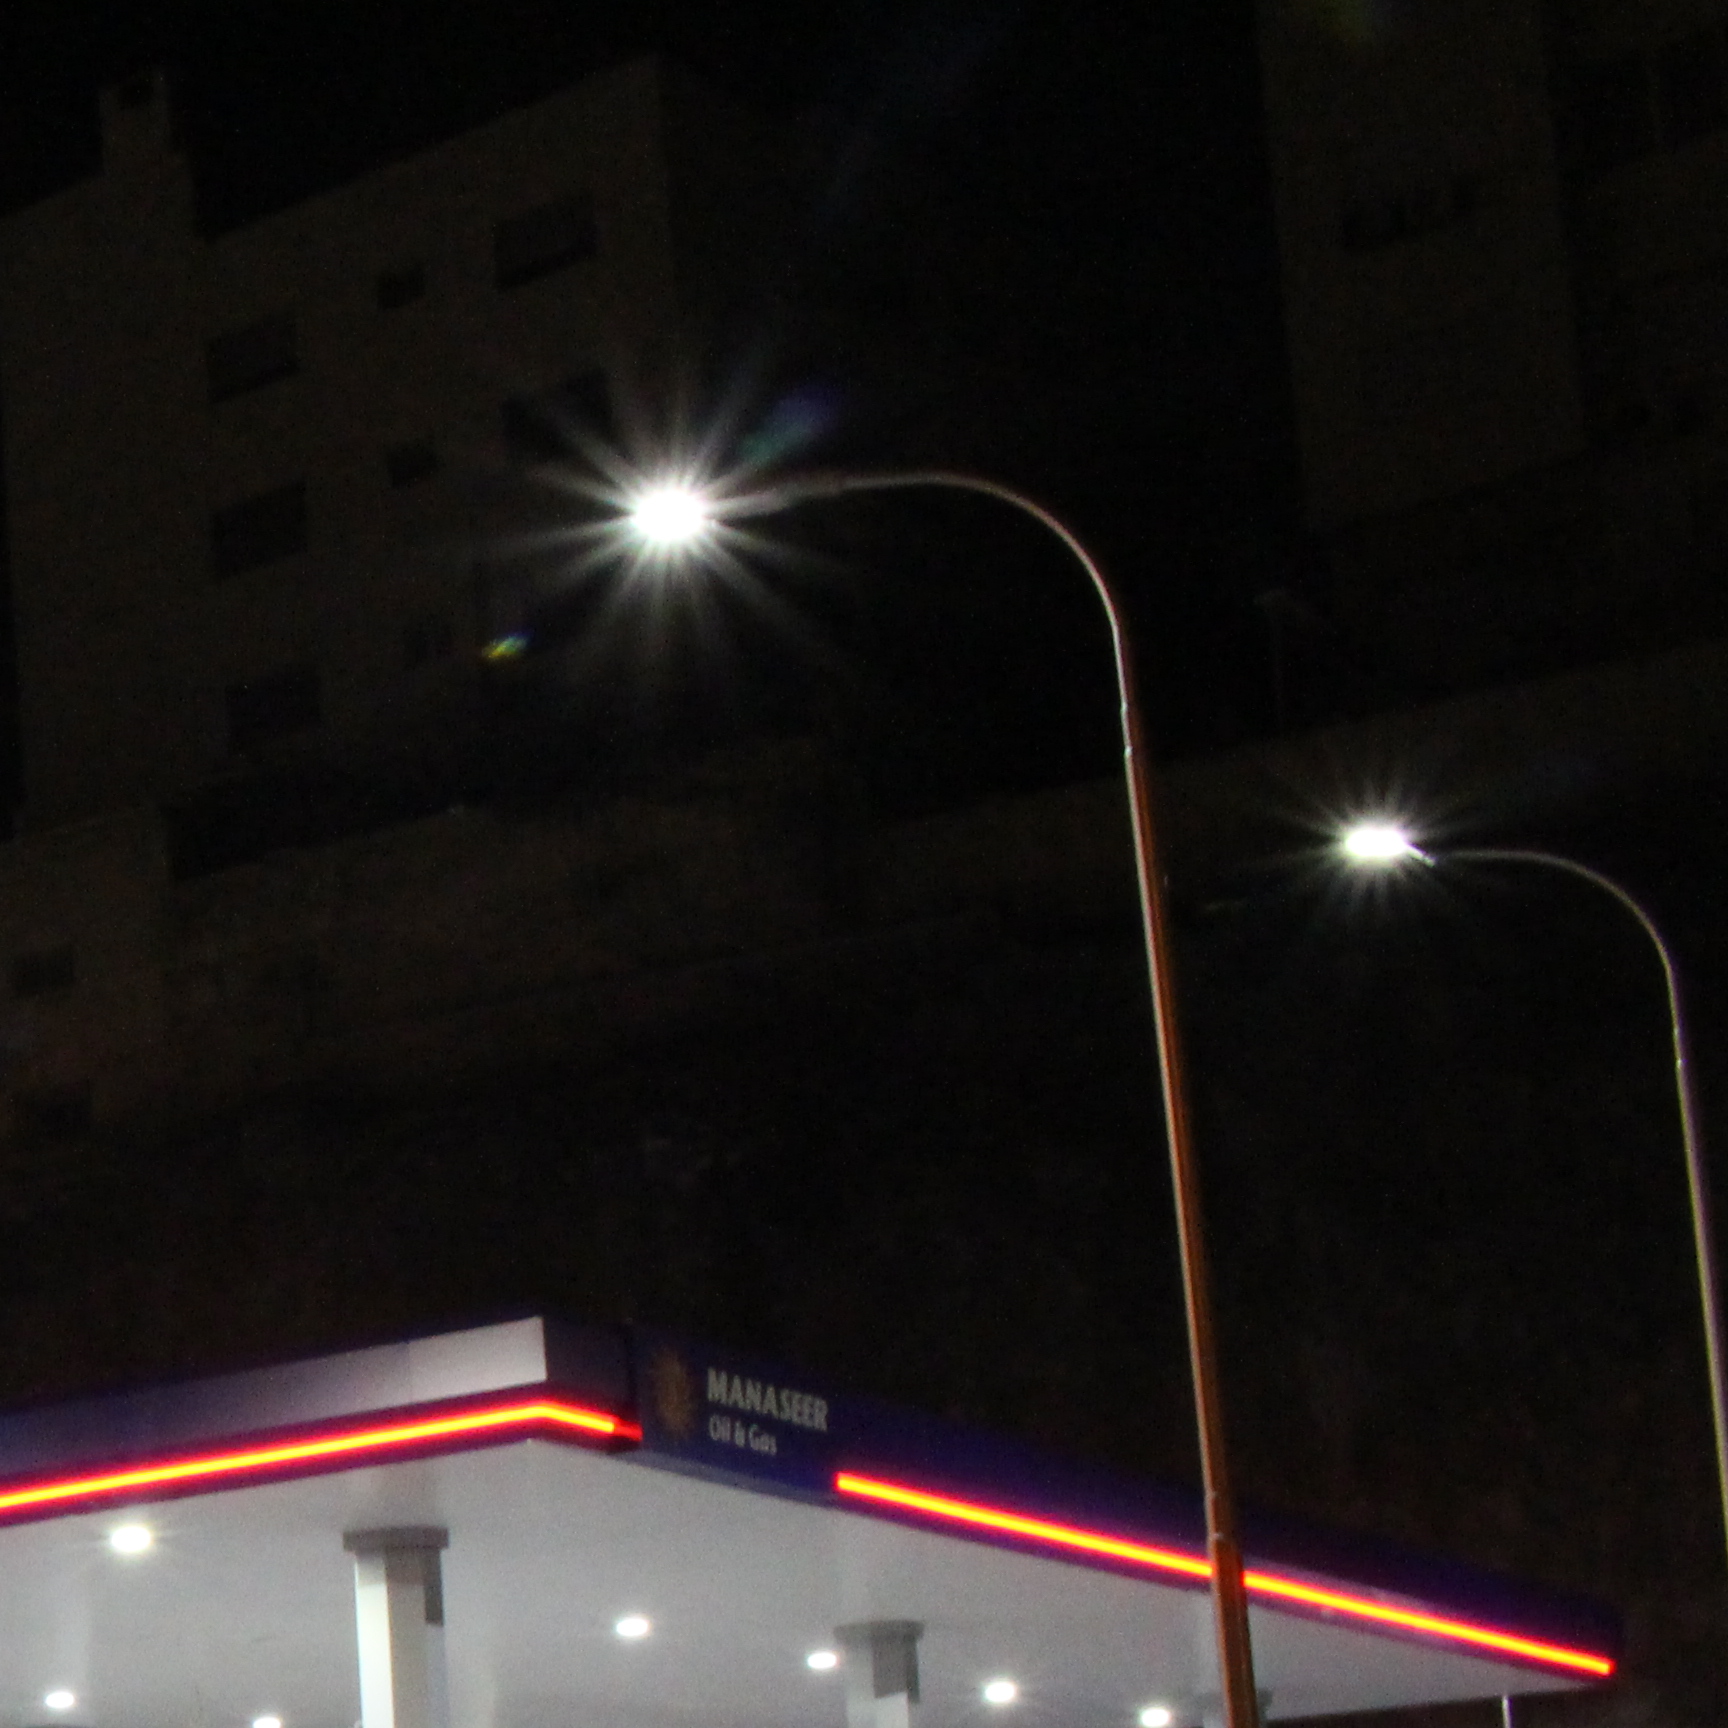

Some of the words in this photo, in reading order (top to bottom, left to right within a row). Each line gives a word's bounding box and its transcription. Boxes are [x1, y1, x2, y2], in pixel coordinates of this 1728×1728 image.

[707, 1367, 829, 1432] MANASEER
[709, 1414, 731, 1442] Oil
[749, 1424, 778, 1455] Gas
